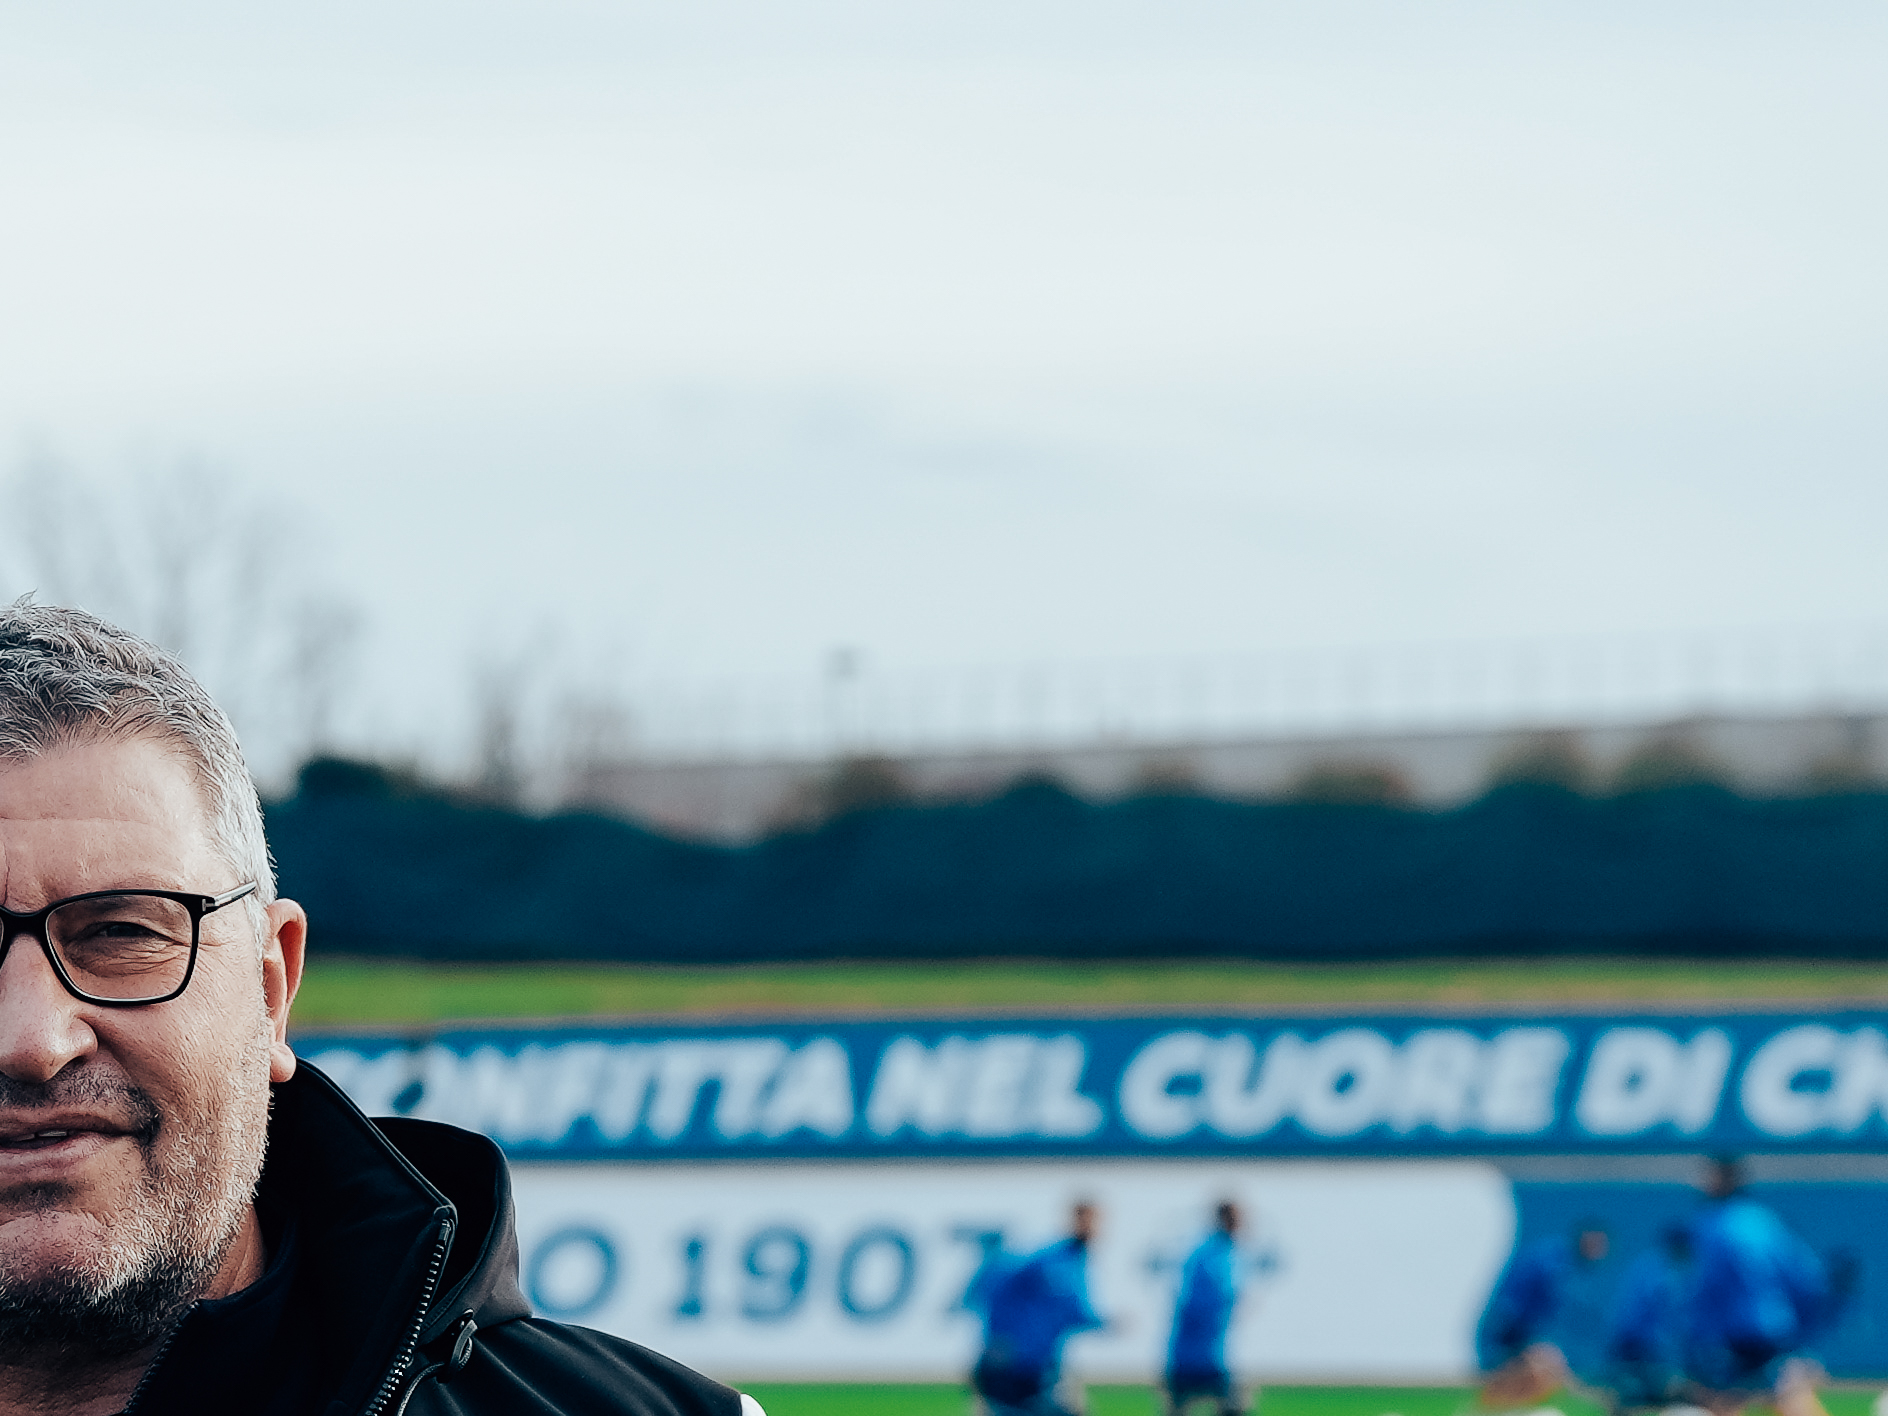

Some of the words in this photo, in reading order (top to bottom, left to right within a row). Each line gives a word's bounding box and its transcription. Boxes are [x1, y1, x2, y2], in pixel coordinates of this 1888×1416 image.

[868, 1034, 1103, 1138] NEL
[1120, 1029, 1568, 1136] CUORE
[1577, 1026, 1733, 1135] DI
